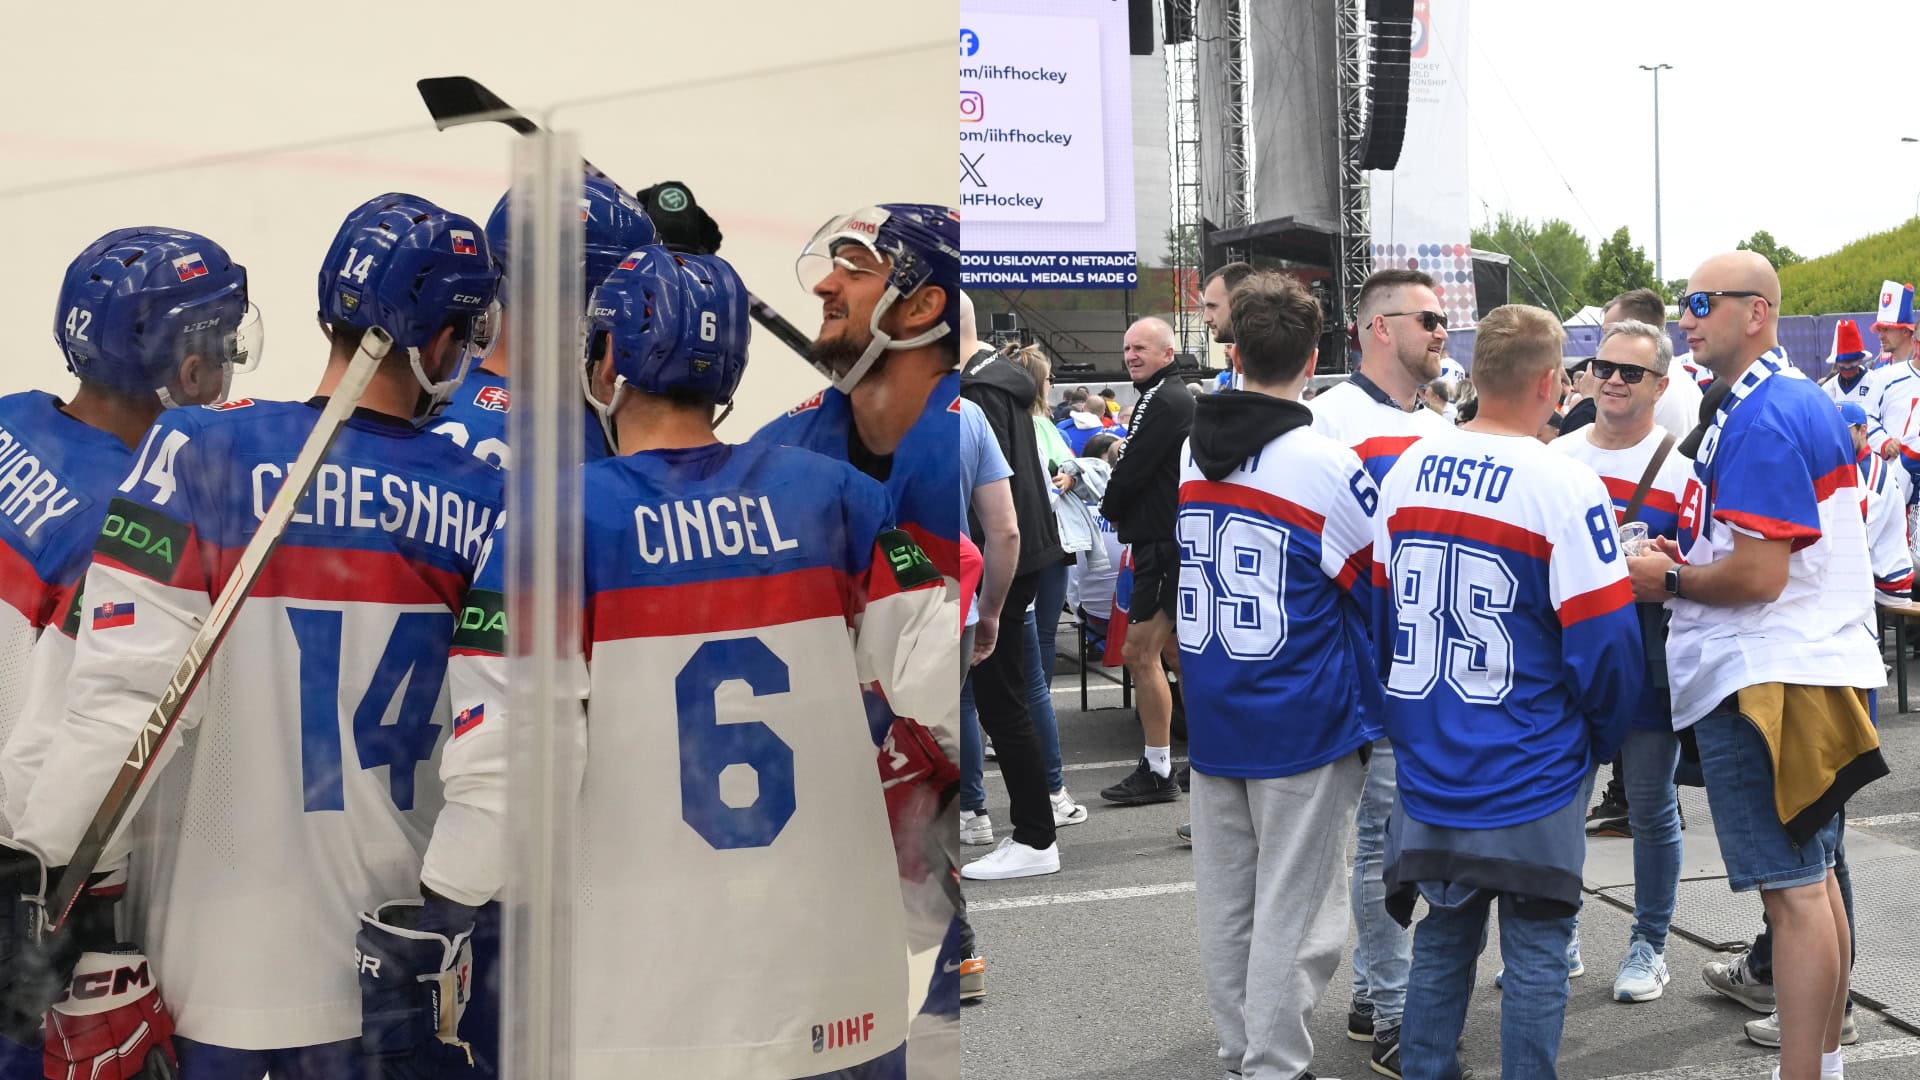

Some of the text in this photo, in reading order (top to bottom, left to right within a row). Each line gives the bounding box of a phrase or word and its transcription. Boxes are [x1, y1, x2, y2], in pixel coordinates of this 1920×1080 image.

[1411, 62, 1440, 71] OCKEY
[339, 247, 374, 284] 14
[960, 255, 990, 266] DOU
[993, 255, 1056, 266] USILOVAT
[1059, 255, 1069, 266] O
[1032, 272, 1084, 284] MEDALS
[1087, 272, 1124, 284] MADE
[453, 293, 482, 305] CCM
[594, 307, 616, 316] CCM
[65, 306, 92, 341] 42
[701, 311, 717, 342] 6
[118, 424, 190, 506] 14
[1416, 454, 1514, 504] RASŤO
[634, 495, 798, 565] CINGEL
[1585, 503, 1618, 564] 8
[889, 544, 933, 573] SK
[1176, 508, 1290, 661] 69
[454, 605, 508, 636] DA
[1385, 539, 1519, 705] 85
[286, 606, 455, 813] 14
[675, 636, 797, 850] 6
[63, 960, 150, 1000] CM
[828, 1012, 874, 1050] IIHF
